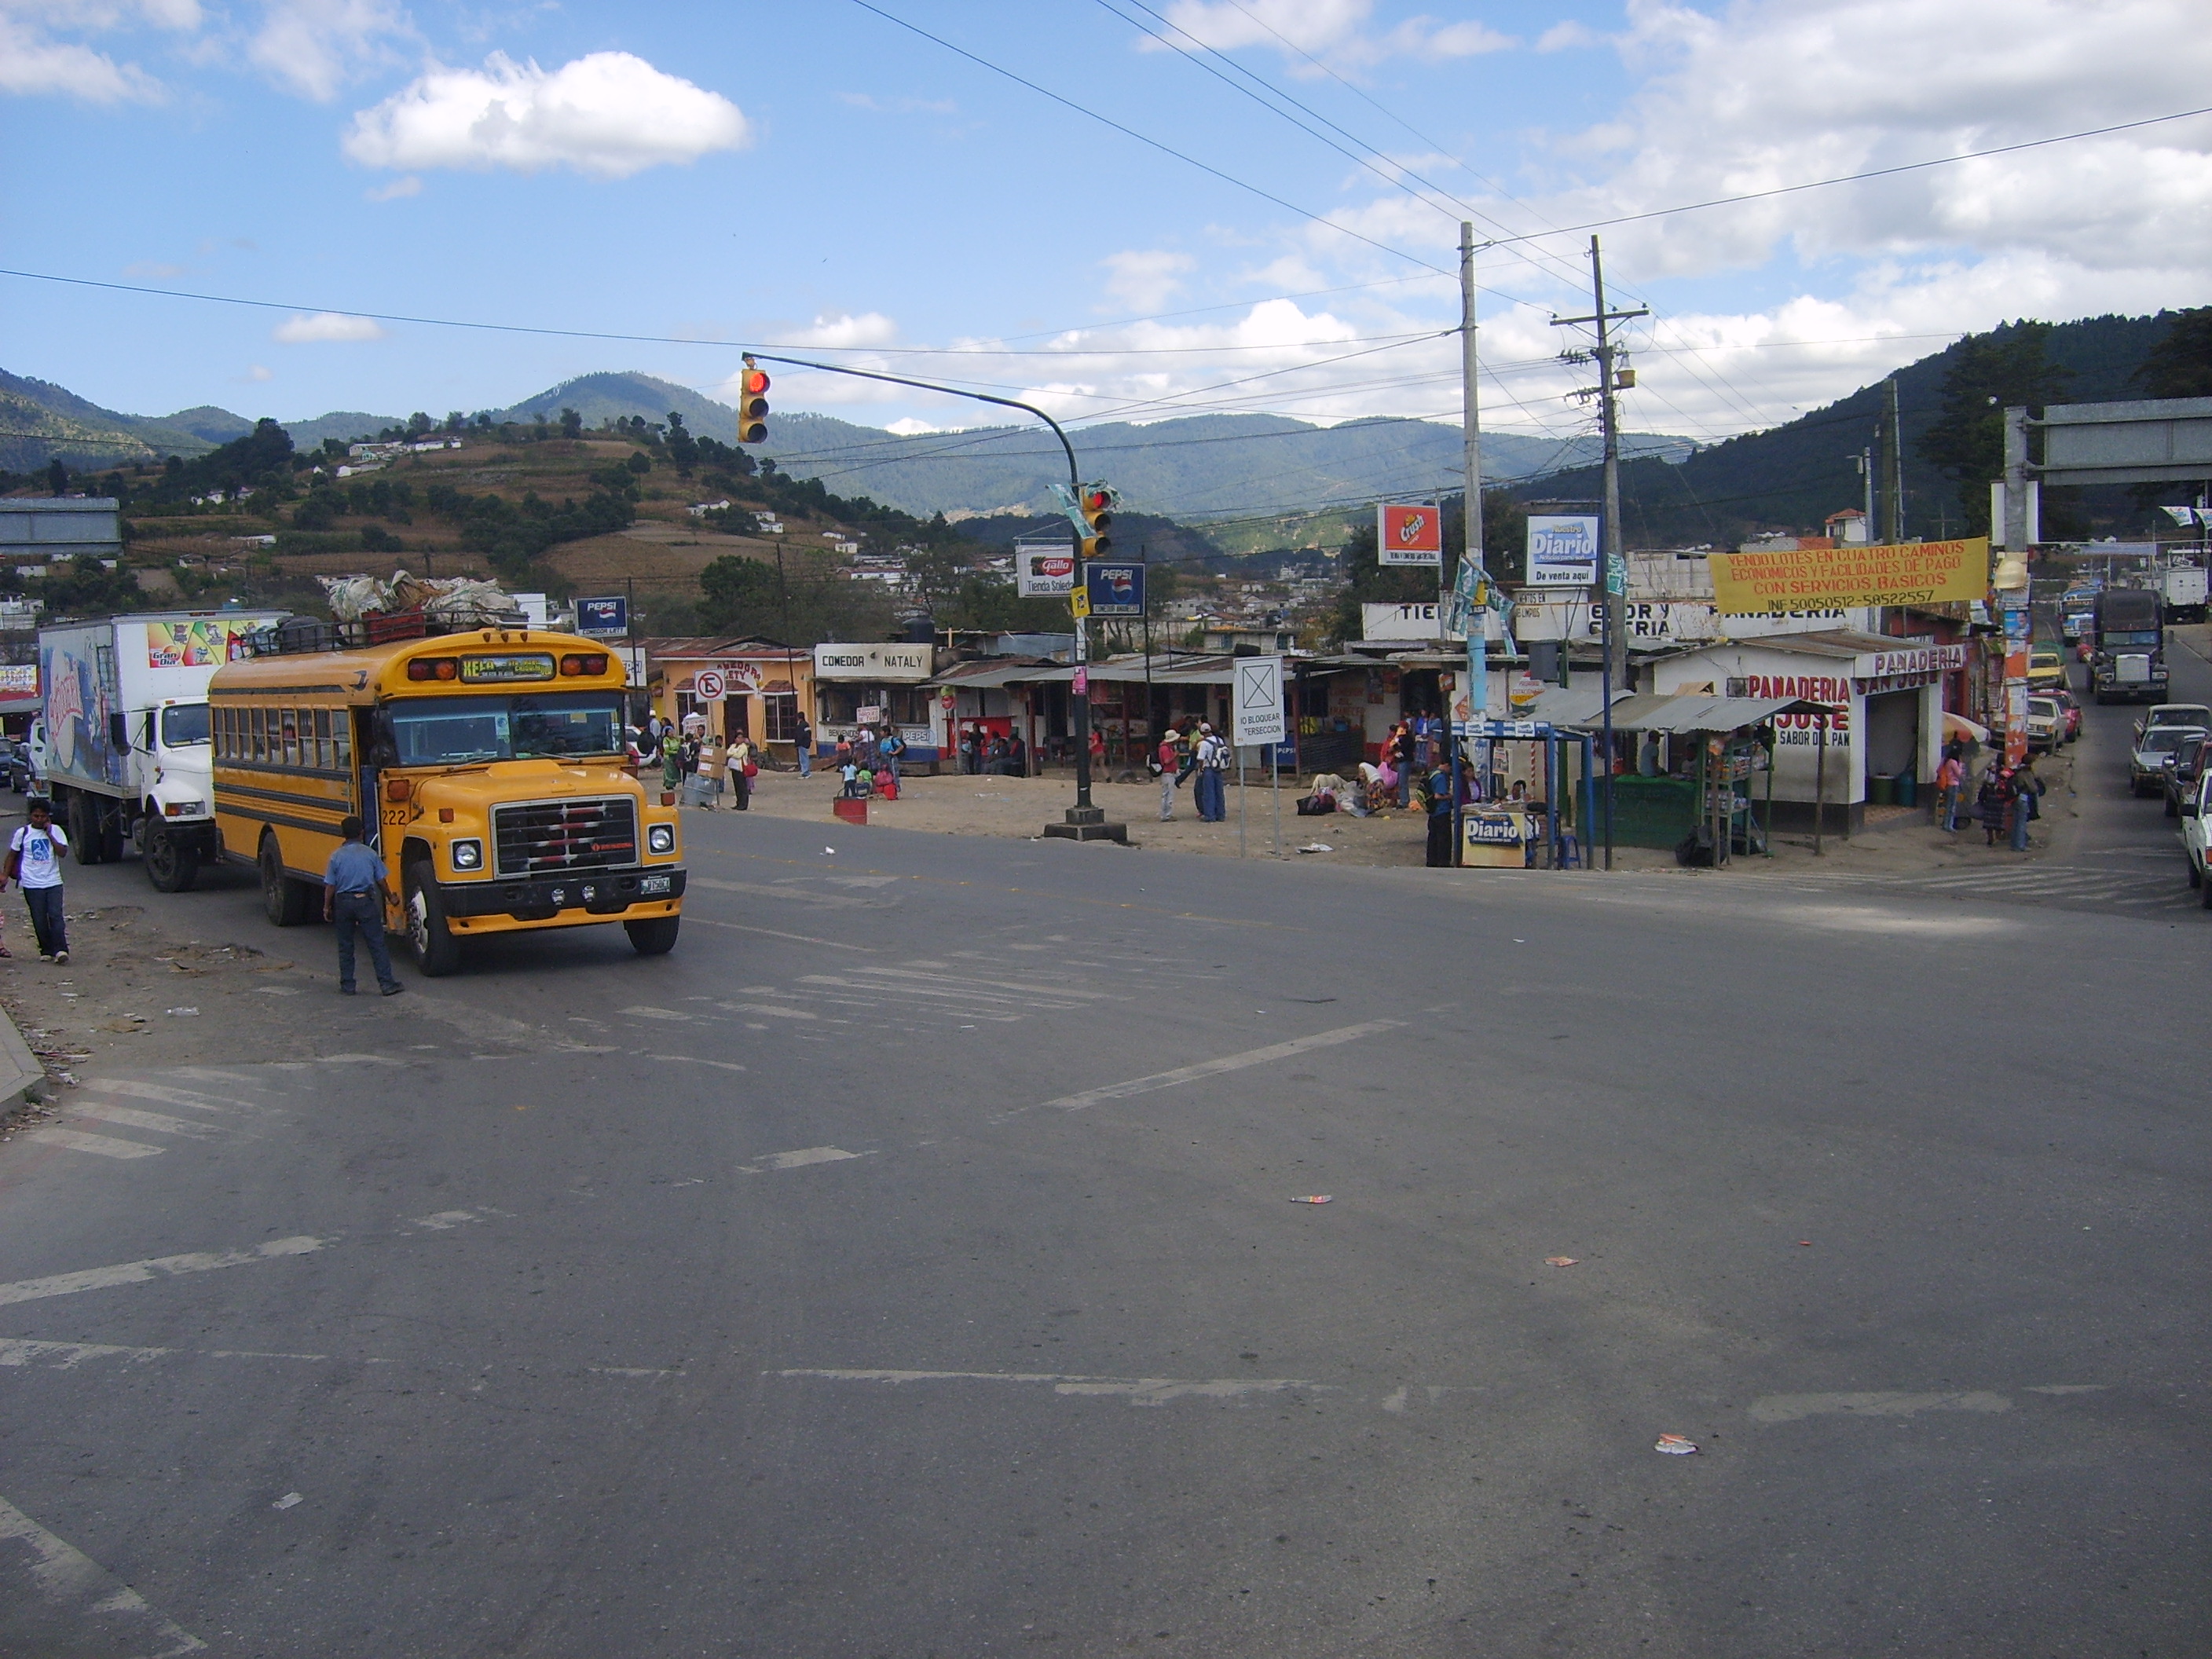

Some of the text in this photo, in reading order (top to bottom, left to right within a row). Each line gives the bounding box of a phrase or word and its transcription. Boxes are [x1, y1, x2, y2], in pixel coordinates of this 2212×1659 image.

[1401, 514, 1425, 542] Crush
[1552, 525, 1582, 533] Nuestro
[1531, 533, 1592, 555] Diario
[1728, 541, 1965, 566] VENDO LOTES EN CUATRO CAMINOS
[1101, 569, 1133, 580] PEPSI
[1731, 555, 1961, 580] ECONOMICOS Y FACILIDADES DE PAGO
[1536, 571, 1546, 580] De
[1548, 571, 1569, 580] venta
[1027, 580, 1050, 591] Tienda
[1755, 573, 1946, 595] CON SERVICIOS BASICOS
[588, 601, 617, 611] PEPSI
[1768, 599, 1787, 610] INF
[1401, 606, 1441, 620] TIE
[822, 655, 923, 668] COMEDOR NATALY
[1875, 646, 1961, 676] PANADERIA
[1749, 675, 1850, 703] PANADERIA
[1857, 670, 1938, 695] SAN JOSE
[1247, 713, 1280, 723] BLOQUEAR
[904, 731, 930, 741] PEPSI
[1780, 731, 1810, 745] SABOR
[1812, 732, 1829, 746] DL
[1832, 732, 1850, 746] PAN
[383, 810, 406, 826] 222
[1467, 819, 1518, 838] Diario
